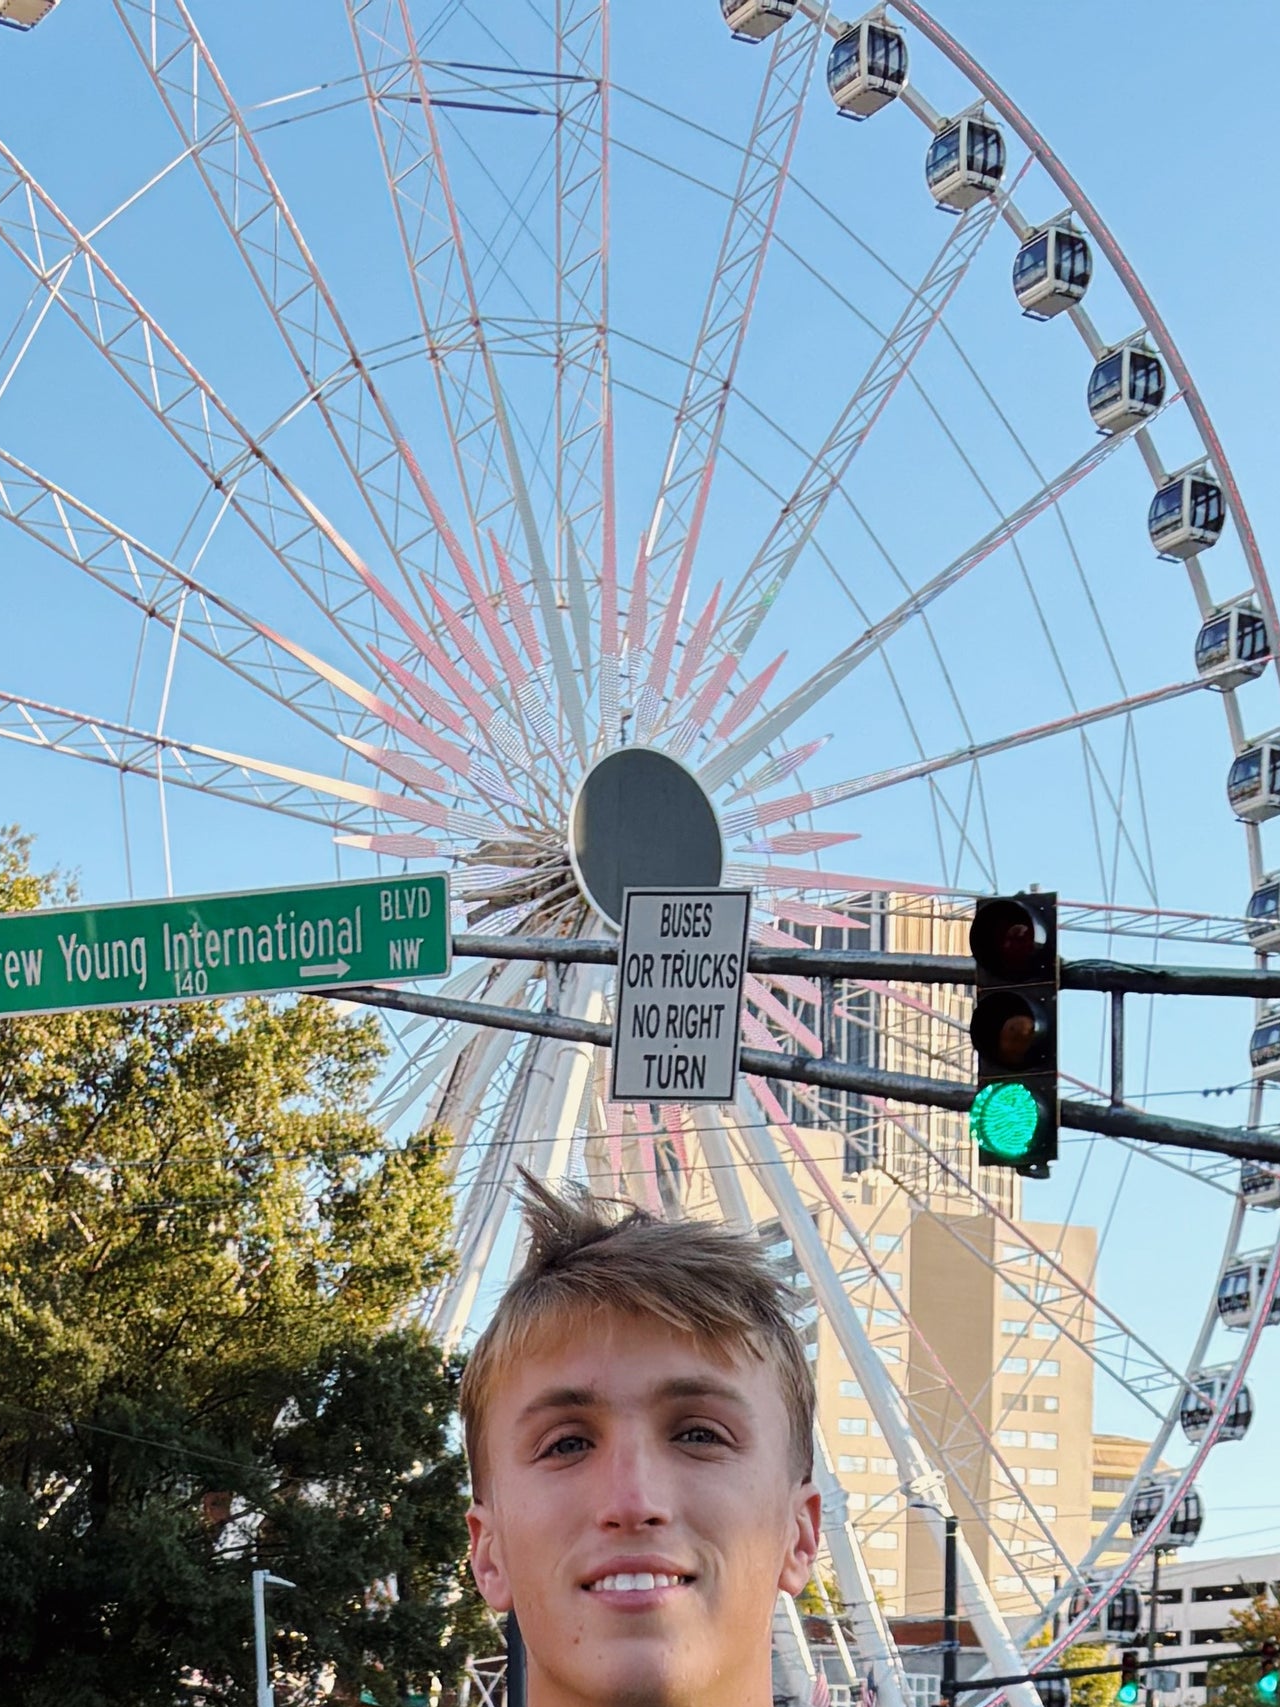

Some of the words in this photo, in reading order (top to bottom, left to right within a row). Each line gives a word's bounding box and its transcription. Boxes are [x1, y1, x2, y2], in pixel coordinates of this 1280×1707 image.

[380, 887, 431, 923] BLVD
[659, 902, 713, 938] BUSES
[58, 932, 147, 991] Young
[163, 905, 363, 972] International
[389, 937, 424, 971] NW
[174, 969, 208, 997] 140
[626, 953, 654, 989] OR
[661, 953, 738, 989] TRUCKS
[632, 1003, 660, 1039] NO
[665, 1003, 725, 1039] RIGHT
[643, 1054, 706, 1089] TURN
